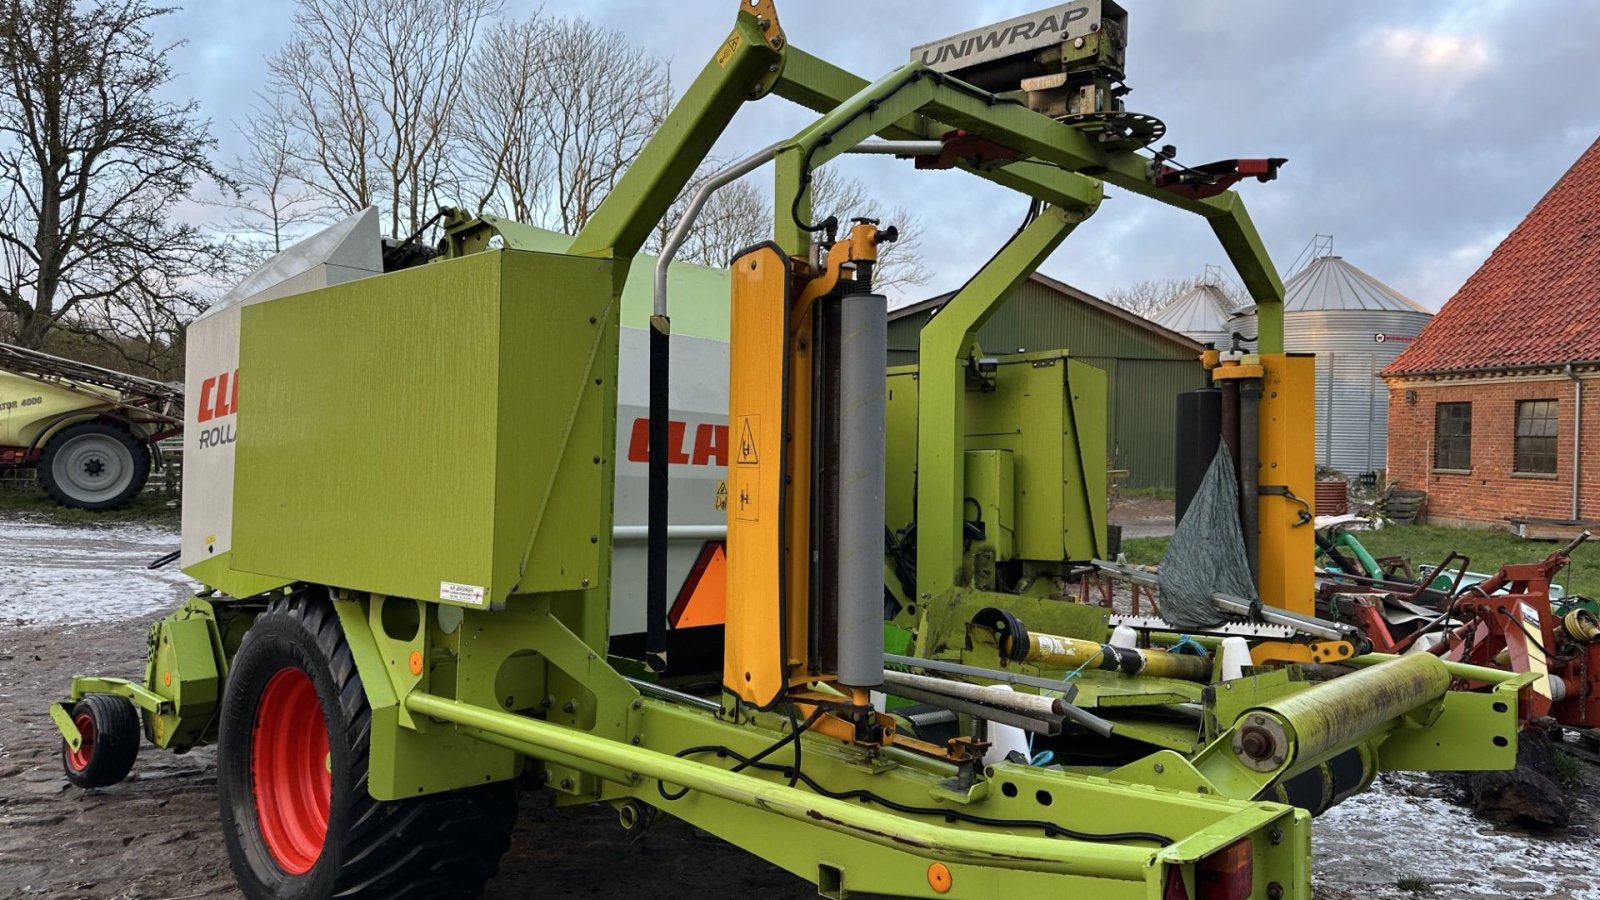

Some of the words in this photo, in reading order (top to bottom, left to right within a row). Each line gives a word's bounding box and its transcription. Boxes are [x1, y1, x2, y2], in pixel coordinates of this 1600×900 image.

[921, 6, 1090, 66] UNIWRAP
[20, 396, 43, 407] 4000
[199, 424, 237, 450] ROLL
